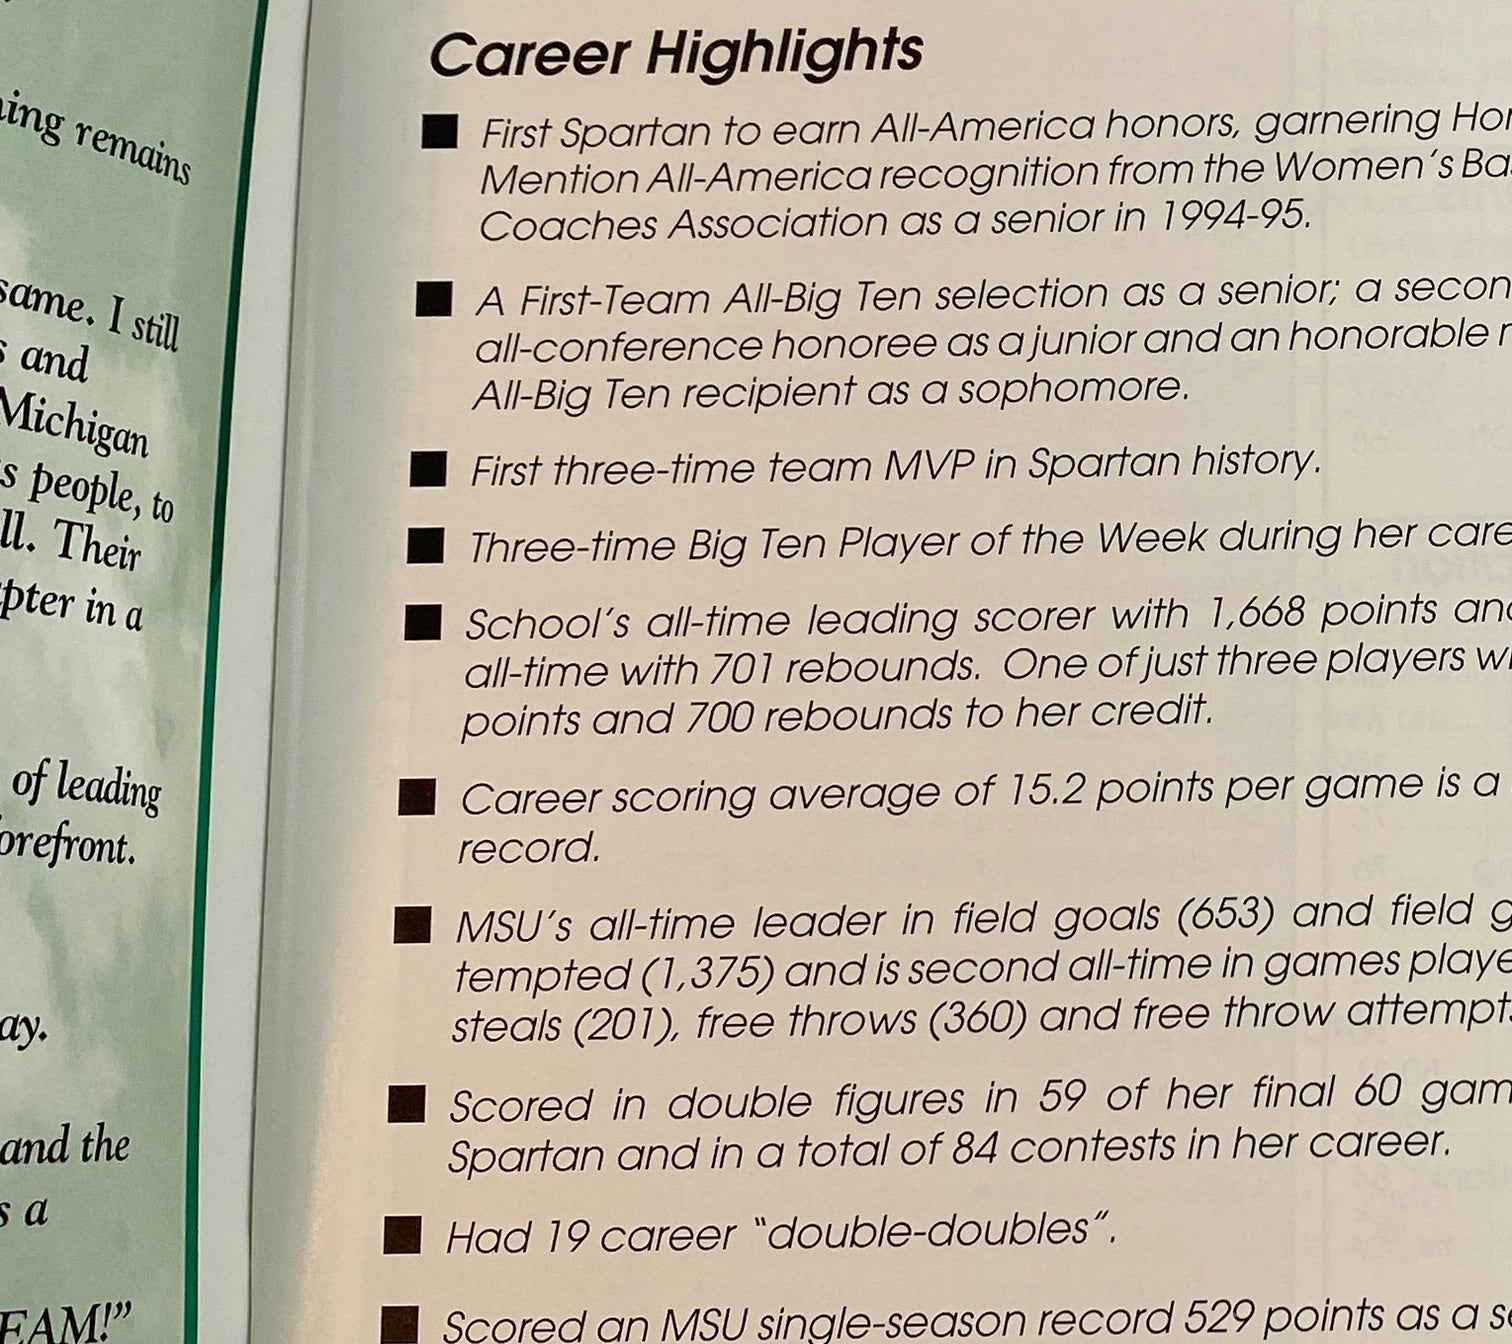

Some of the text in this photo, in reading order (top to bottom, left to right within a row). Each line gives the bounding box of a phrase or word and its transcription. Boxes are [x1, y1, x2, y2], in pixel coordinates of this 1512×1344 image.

[431, 26, 924, 85] Career Highlights
[75, 121, 191, 186] remains
[483, 118, 553, 148] First
[561, 117, 710, 154] Spartan
[725, 116, 761, 145] to
[773, 121, 860, 145] earn
[871, 110, 1095, 143] All-America
[1106, 109, 1239, 138] honors,
[1255, 103, 1440, 143] garnering
[481, 198, 1309, 241] Coaches Association as a senior in 1994-95.
[109, 294, 124, 334] I
[131, 313, 180, 353] still
[20, 344, 89, 383] and
[0, 386, 148, 458] Michigan
[28, 462, 174, 523] people, to
[53, 518, 141, 572] Their
[85, 587, 143, 632] in a
[648, 606, 790, 637] all-time
[808, 603, 958, 641] leading
[974, 606, 1096, 632] scorer
[1112, 598, 1188, 629] with
[1214, 595, 1305, 630] 1,668
[1321, 593, 1437, 633] points
[12, 758, 161, 819] of leading
[463, 783, 603, 815] Career
[612, 780, 756, 819] scoring
[770, 783, 940, 816] average
[955, 774, 997, 806] of
[1014, 772, 1086, 805] 15.2
[1096, 771, 1214, 811] points
[1225, 776, 1295, 808] per
[1305, 774, 1423, 808] game
[1437, 766, 1460, 797] is
[1474, 773, 1500, 797] a
[458, 831, 598, 864] record.
[1, 1121, 130, 1165] and the
[24, 1199, 48, 1227] a
[447, 1221, 532, 1253] Had
[551, 1220, 590, 1252] 19
[601, 1225, 737, 1252] career
